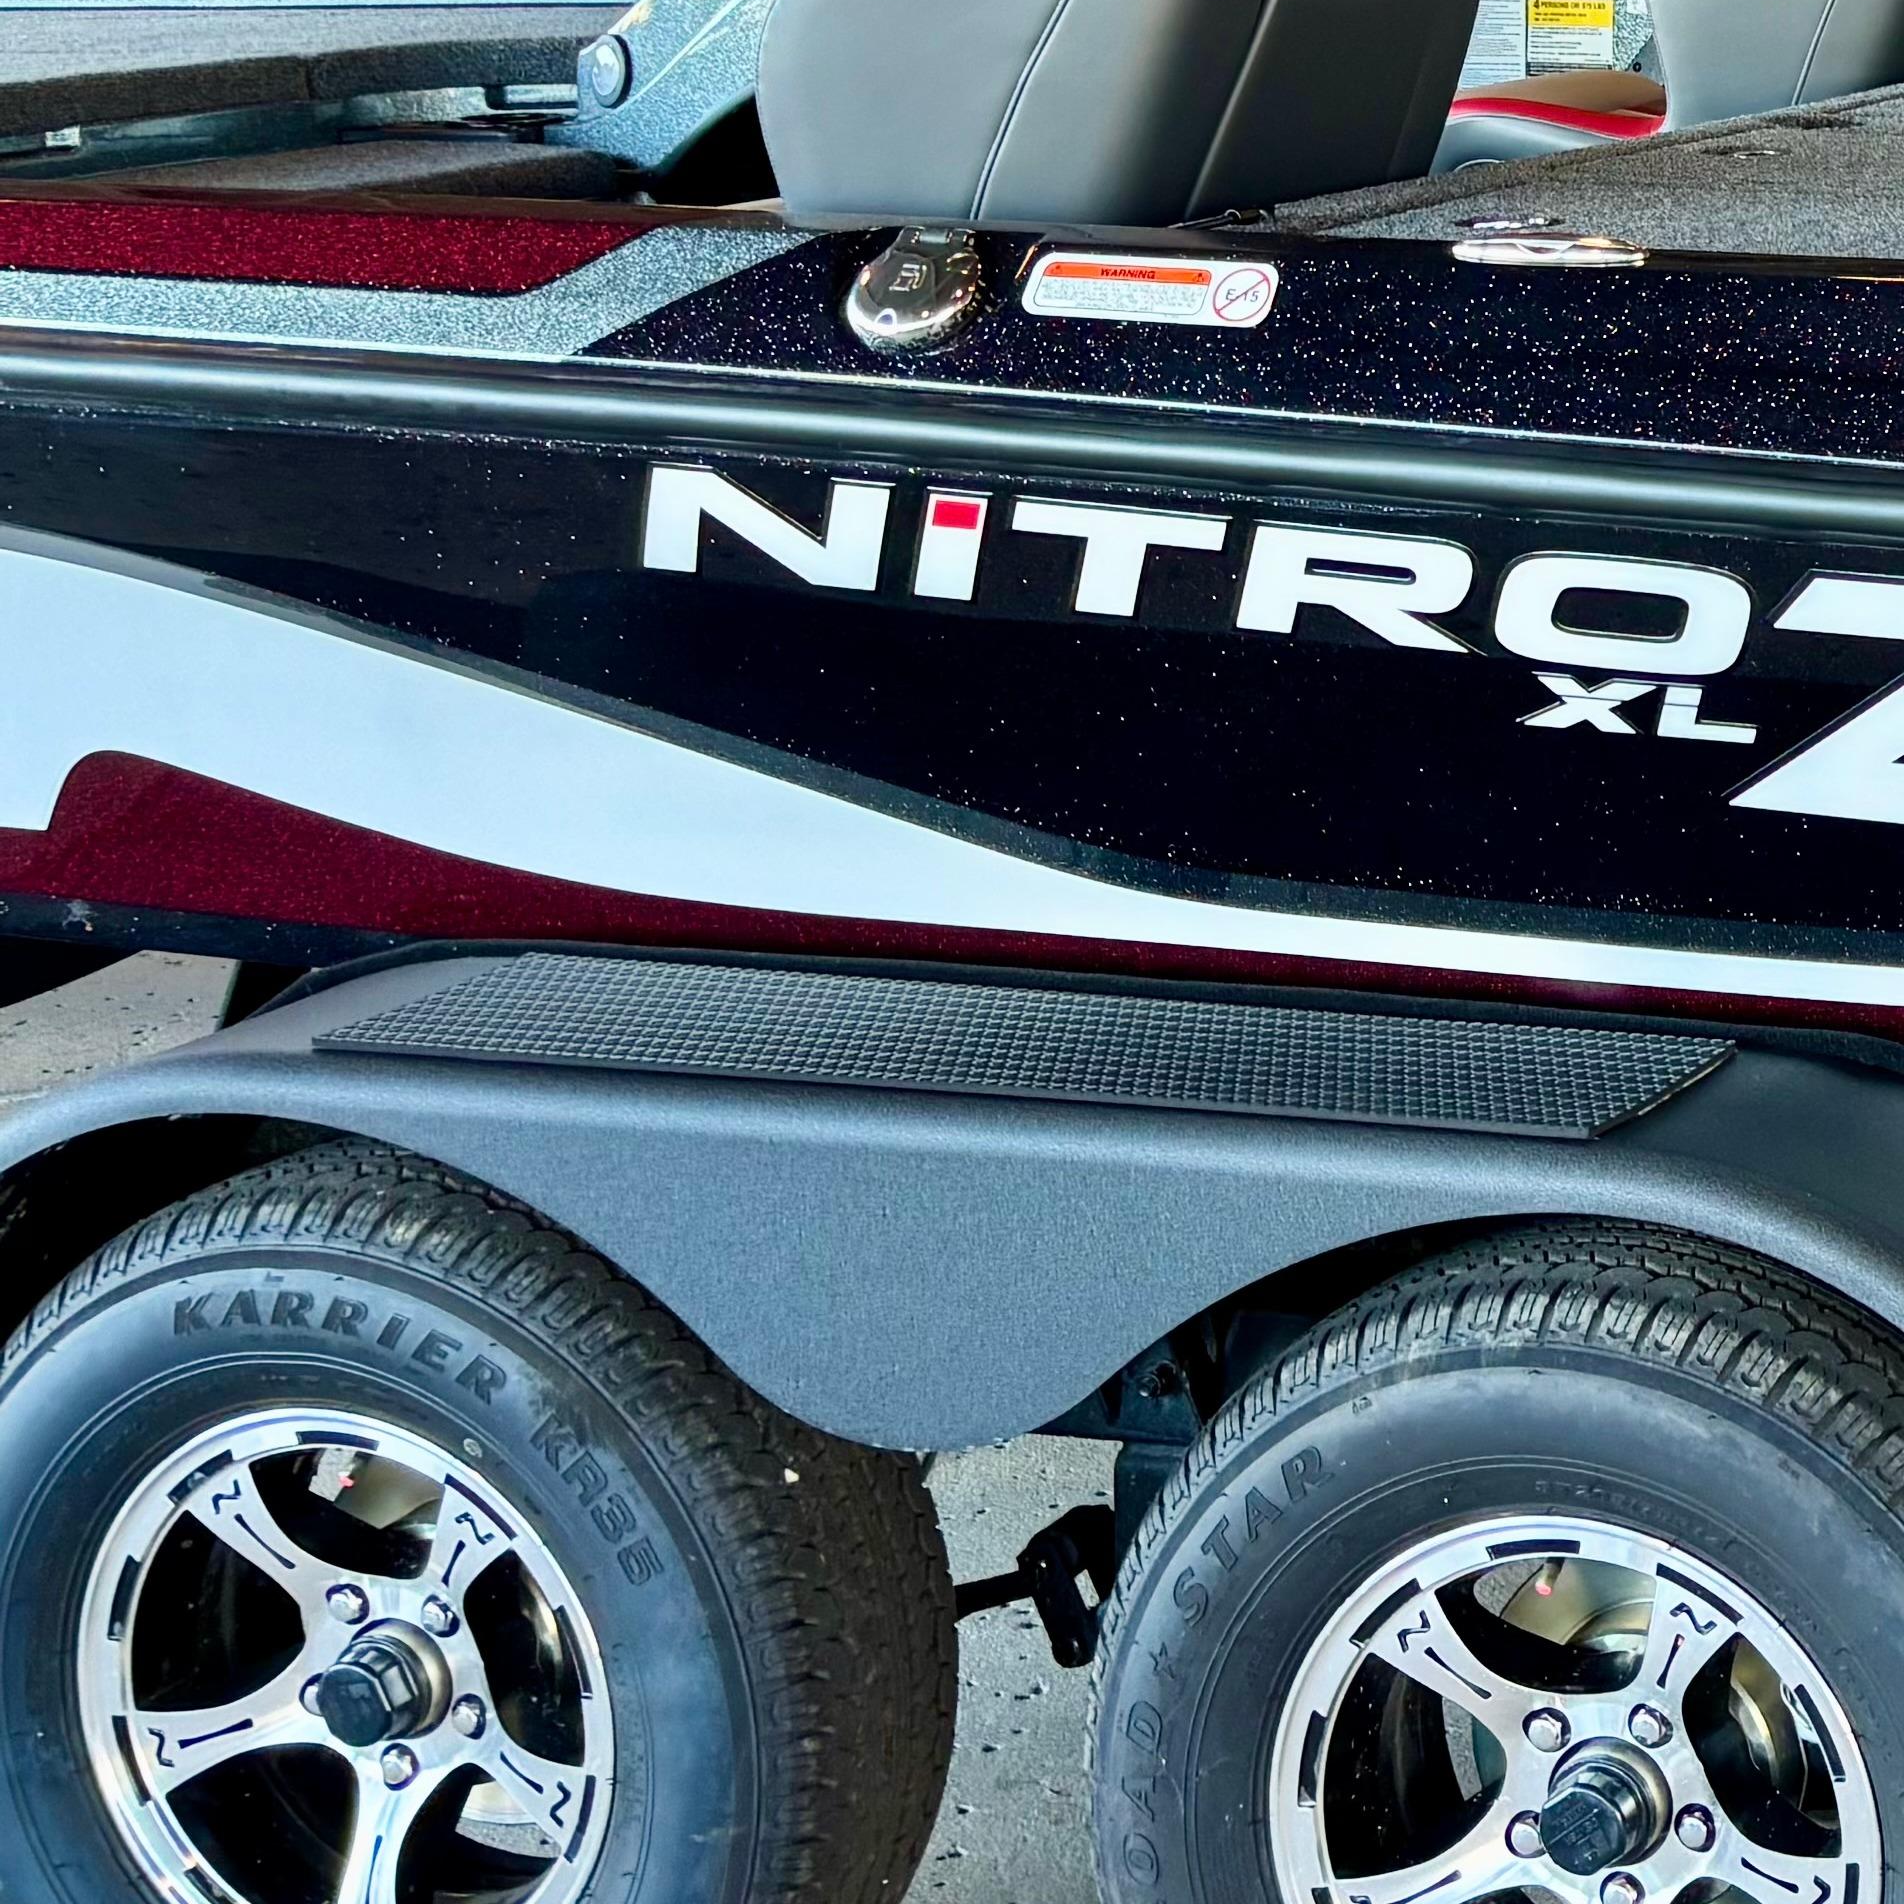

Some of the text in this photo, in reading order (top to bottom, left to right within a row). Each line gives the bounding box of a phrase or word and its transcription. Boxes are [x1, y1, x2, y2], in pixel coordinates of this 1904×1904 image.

[1100, 267, 1156, 280] WARNING
[1517, 669, 1760, 746] XL
[172, 1288, 665, 1588] KARRIER KR35
[1173, 1444, 1337, 1629] STAR
